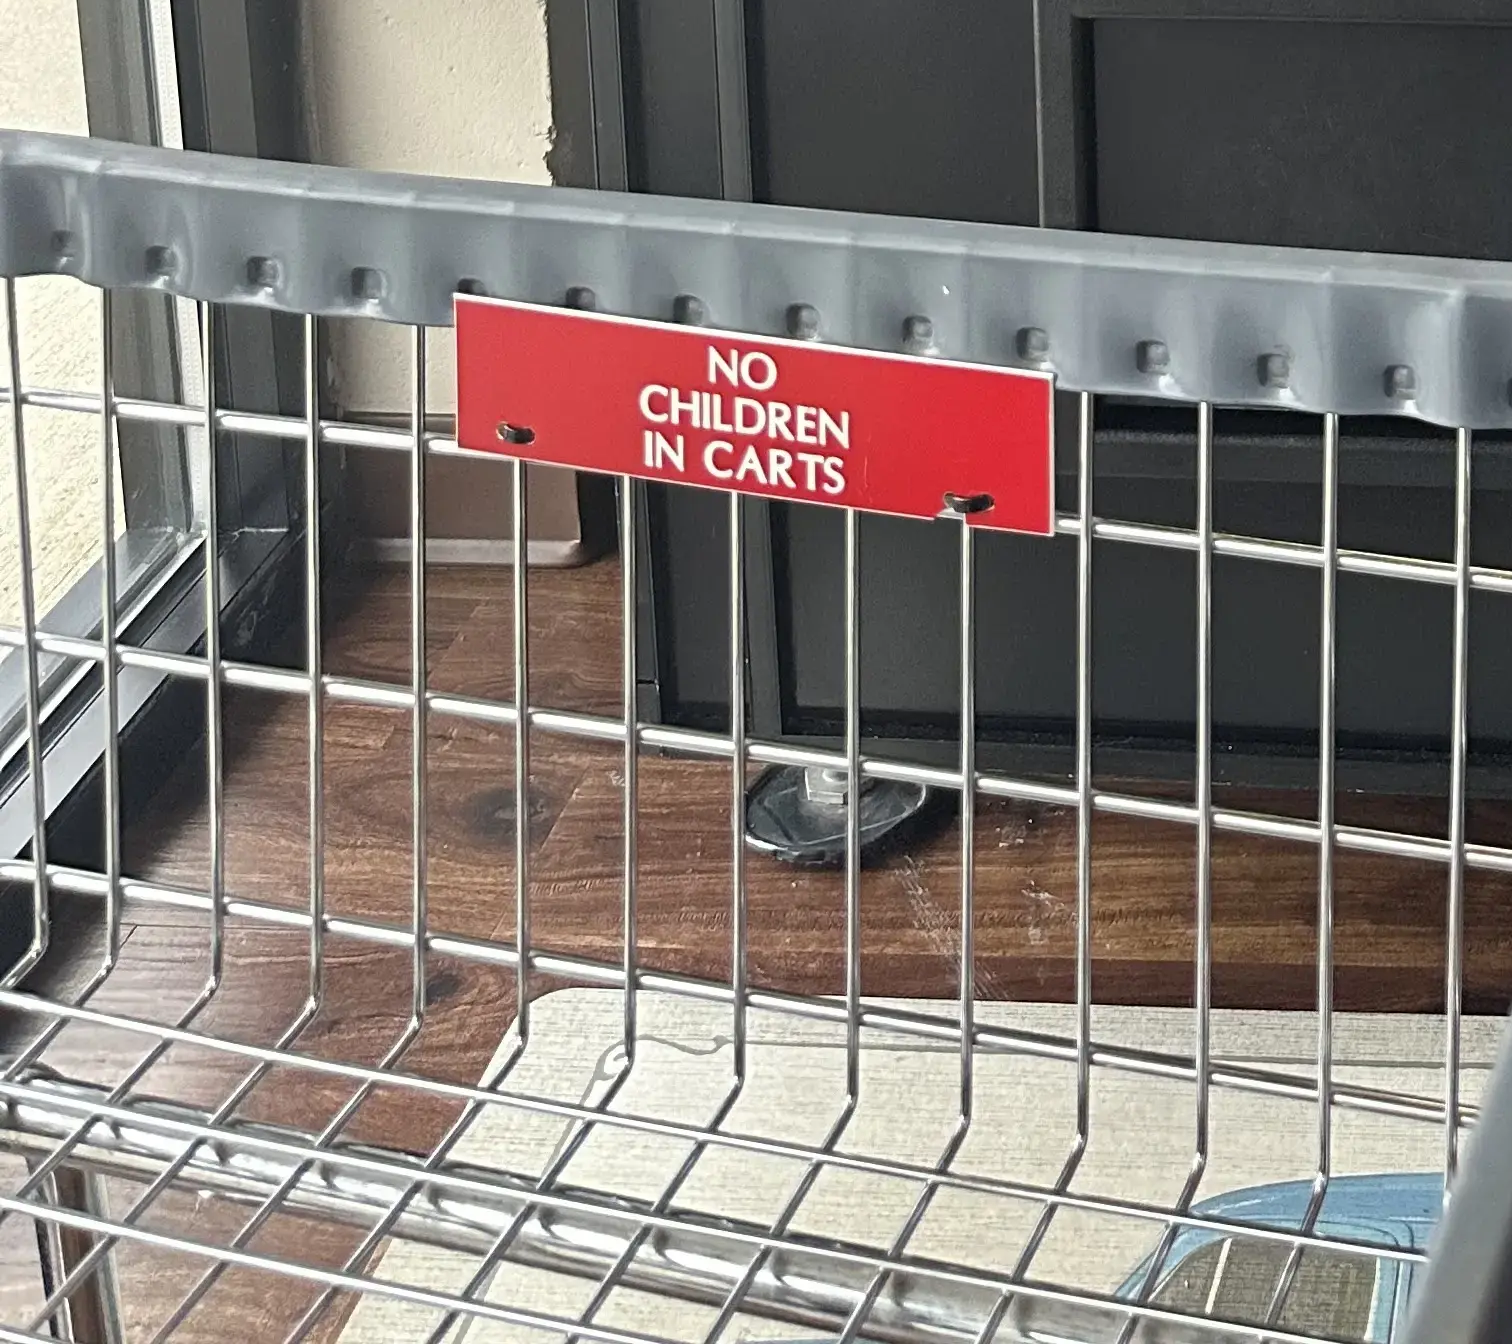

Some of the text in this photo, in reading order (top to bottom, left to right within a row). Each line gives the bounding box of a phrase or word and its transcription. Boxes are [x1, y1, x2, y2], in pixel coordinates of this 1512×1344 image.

[708, 345, 778, 392] NO
[639, 383, 851, 450] CHILDREN
[644, 428, 847, 496] IN CARTS
